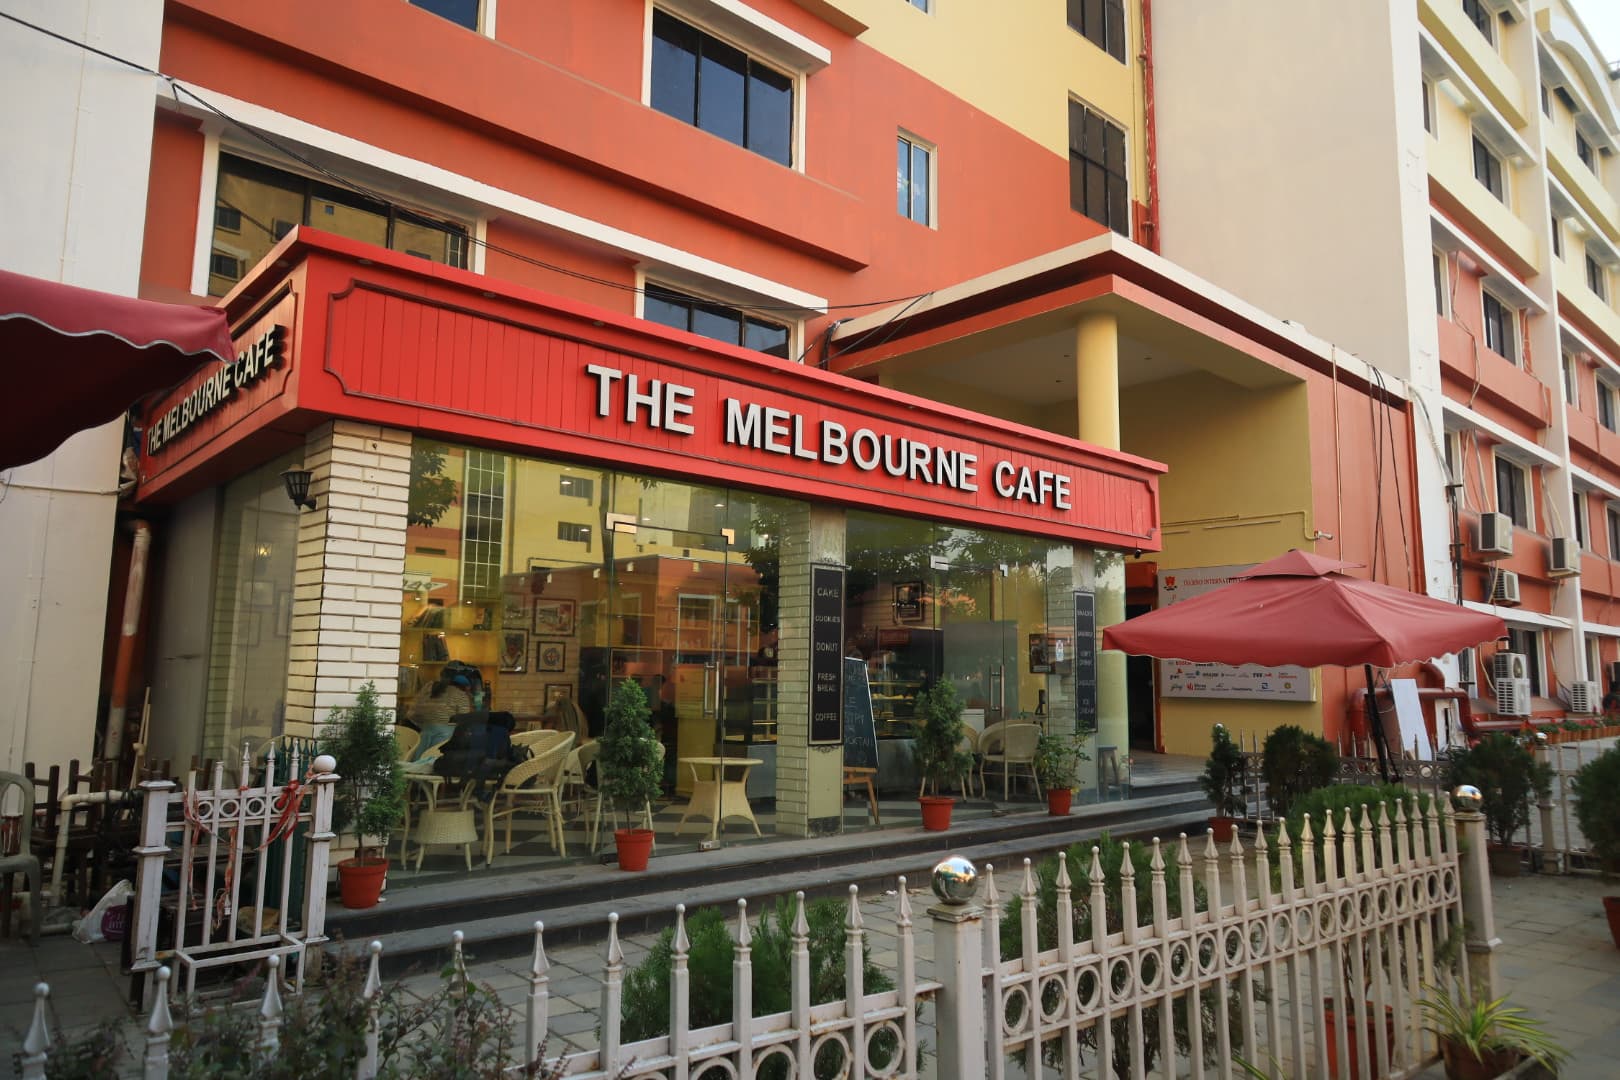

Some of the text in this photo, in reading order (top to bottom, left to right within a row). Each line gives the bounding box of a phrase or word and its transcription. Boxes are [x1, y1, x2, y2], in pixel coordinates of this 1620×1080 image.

[146, 323, 277, 457] THE MELBOURNE CAFE
[587, 364, 1072, 511] THE MELBOURNE CAFE
[816, 587, 840, 598] CAKE
[815, 615, 841, 623] COOKIES
[816, 642, 839, 652] DONUT
[817, 672, 837, 681] FRESH
[815, 712, 837, 721] COFFEE
